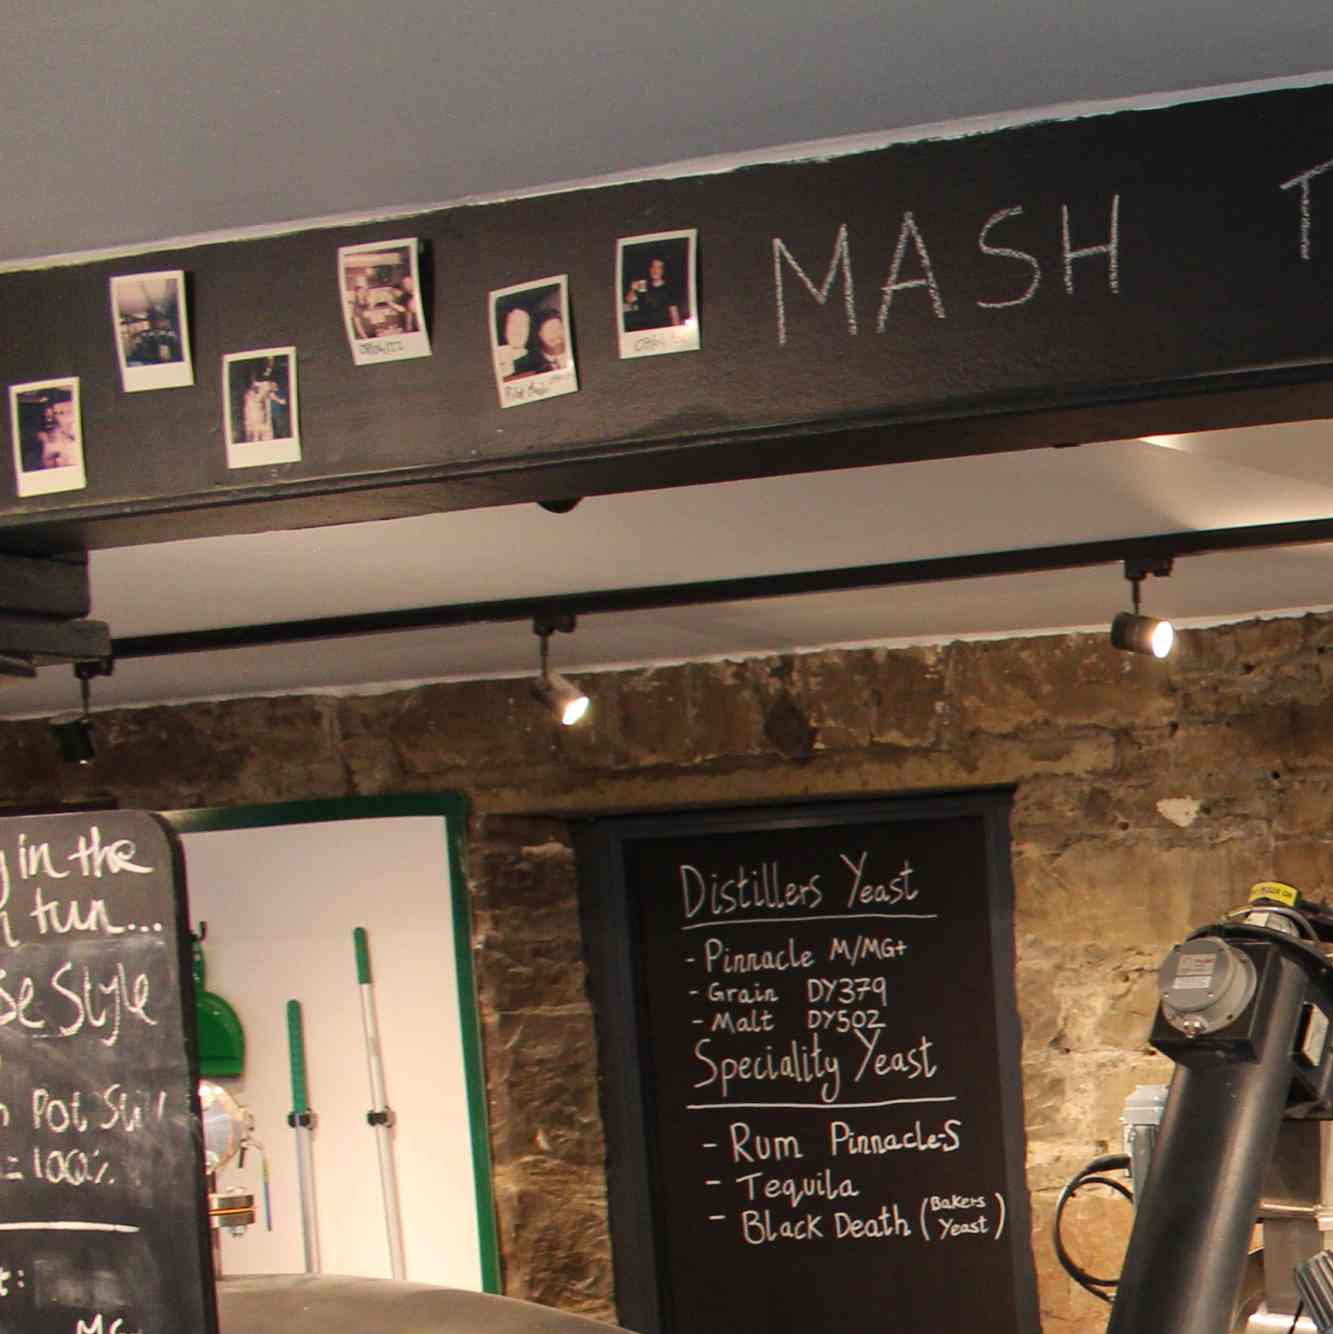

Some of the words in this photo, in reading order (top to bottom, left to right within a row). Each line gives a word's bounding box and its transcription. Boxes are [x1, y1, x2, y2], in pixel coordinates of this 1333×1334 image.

[771, 194, 1121, 346] MASH
[18, 833, 71, 880] in
[67, 826, 155, 879] the
[680, 861, 822, 918] Distillers
[840, 851, 919, 908] Yeast
[705, 937, 815, 973] Pinnacle
[829, 935, 907, 967] M/MG+
[51, 961, 159, 1047] Style
[707, 982, 779, 1003] Grain
[807, 976, 887, 1007] DY379
[711, 1009, 775, 1034] Malt
[807, 1009, 887, 1033] DY502
[693, 1032, 841, 1102] Speciality
[853, 1028, 937, 1083] Yeast
[32, 1088, 89, 1133] Pot
[730, 1122, 804, 1163] Rum
[736, 1168, 860, 1208] Tequila
[742, 1209, 824, 1245] Black
[835, 1203, 912, 1240] Death
